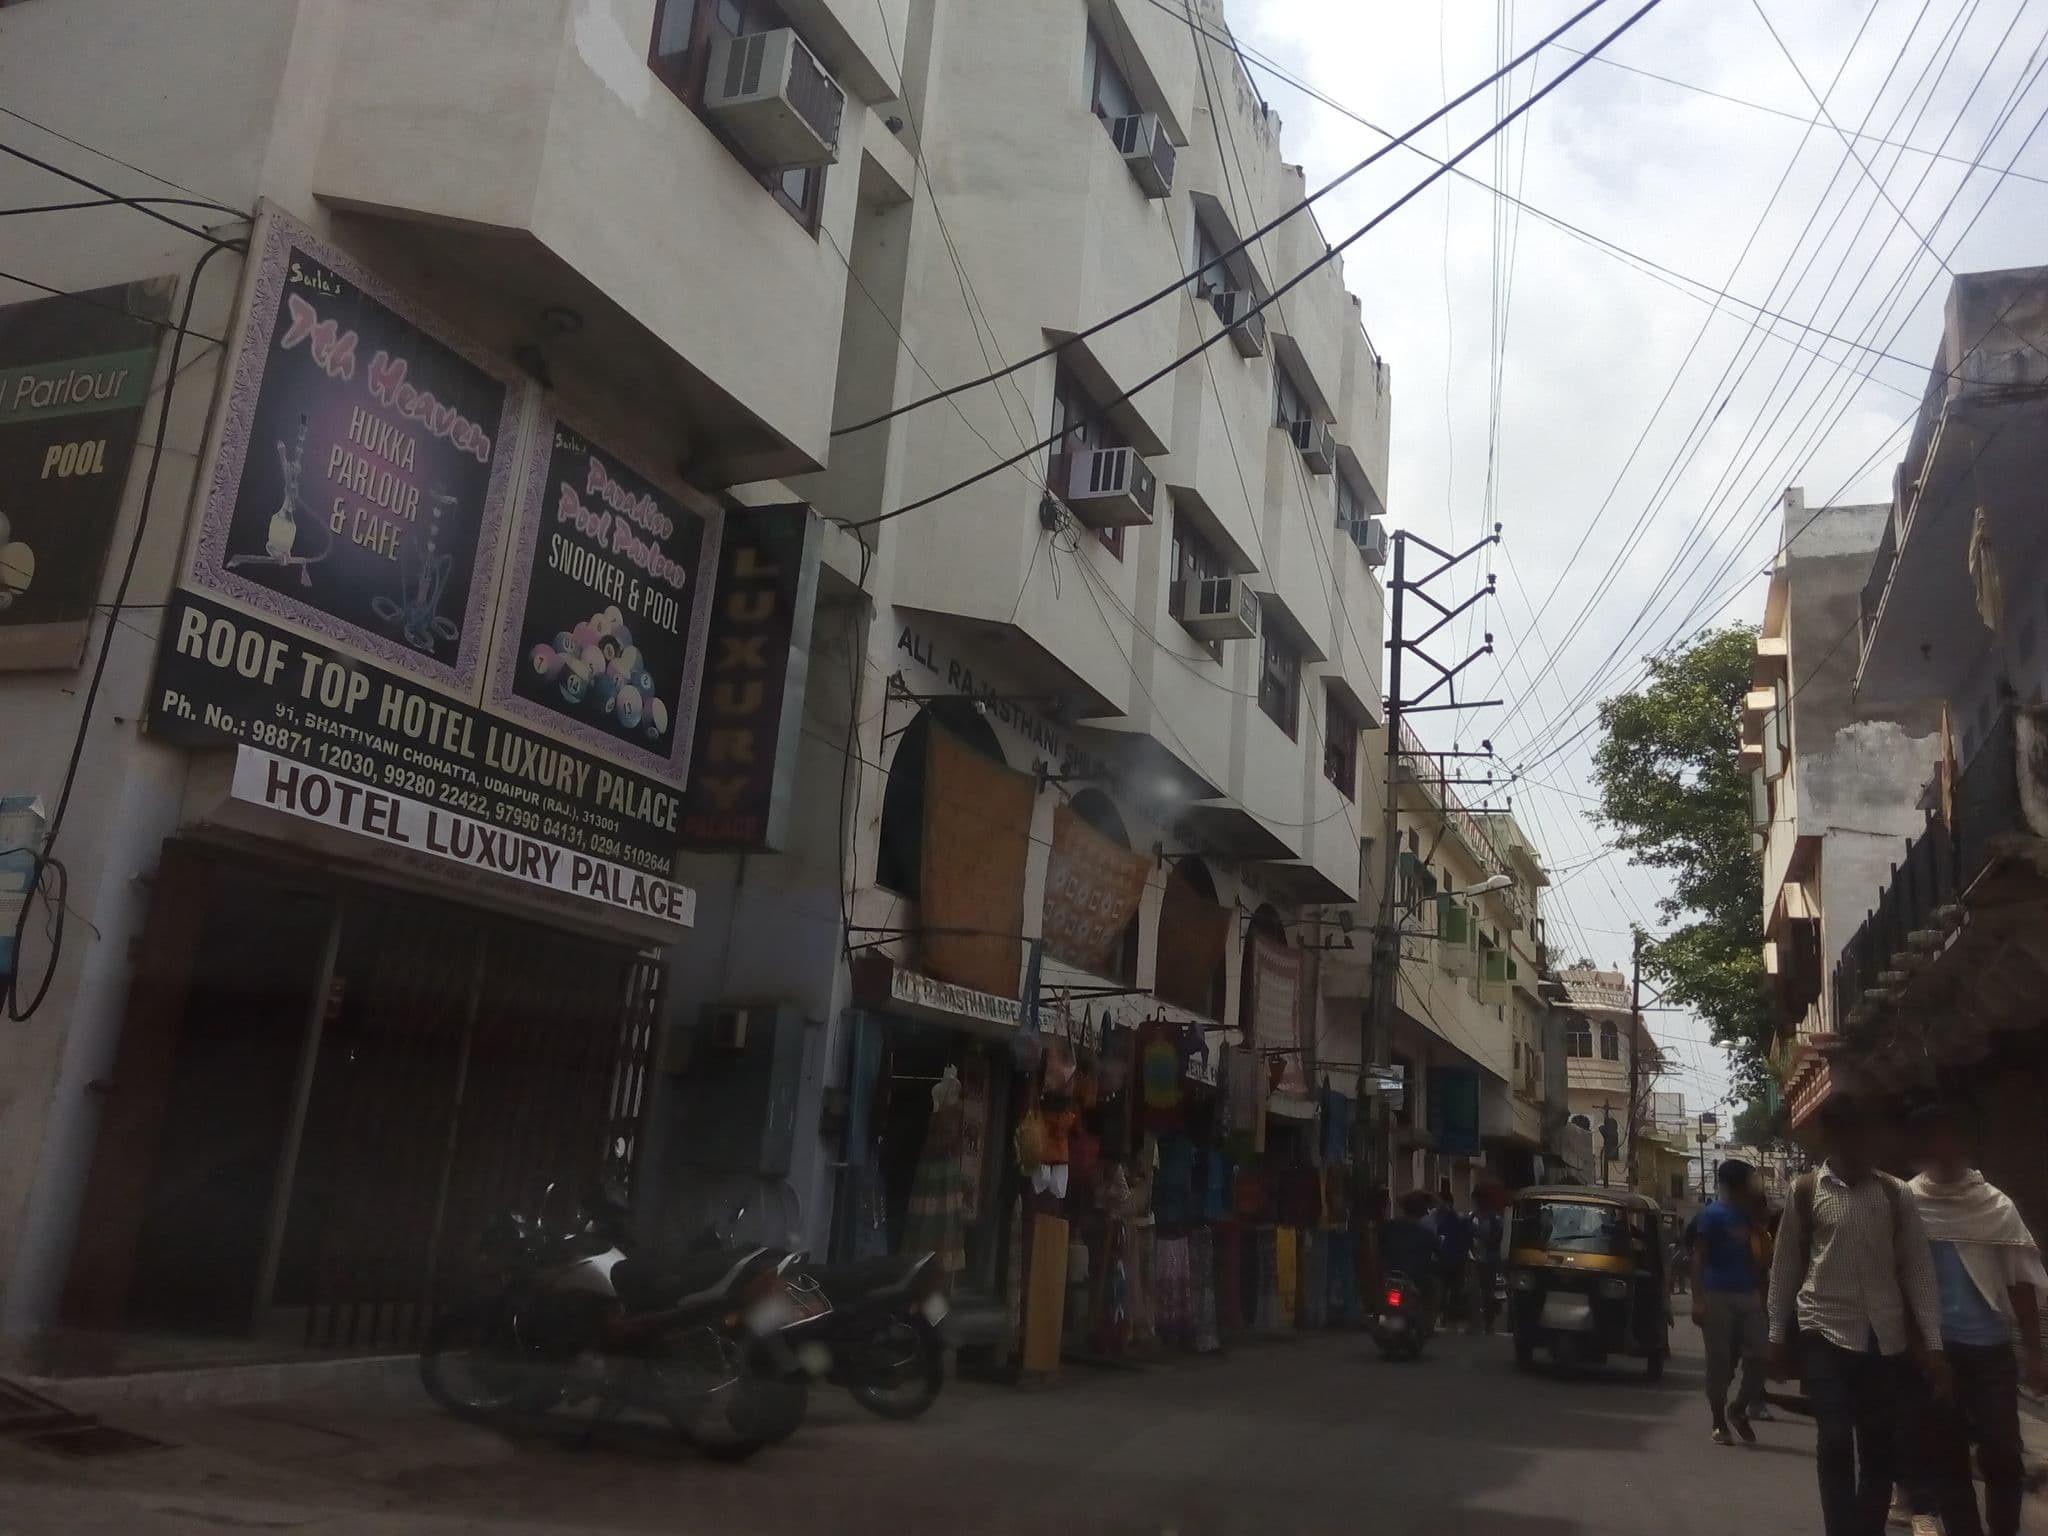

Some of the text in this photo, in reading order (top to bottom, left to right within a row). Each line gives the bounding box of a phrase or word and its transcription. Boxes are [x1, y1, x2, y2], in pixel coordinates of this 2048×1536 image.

[12, 367, 129, 410] Parlour
[368, 350, 491, 463] Heaven
[40, 439, 108, 480] POOL
[327, 443, 420, 523] PARLOUR
[349, 405, 416, 473] HUKKA
[329, 497, 402, 561] & CAFE
[557, 481, 611, 548] Pool
[549, 533, 679, 635] SNOOKER & POOL
[700, 547, 783, 812] LUXURY
[897, 626, 938, 675] ALL
[176, 606, 680, 833] ROOF TOP HOTEL LUXURY PALACE
[162, 690, 197, 721] Ph.
[204, 703, 247, 737] No.:
[252, 720, 313, 757] 98871
[319, 743, 378, 784] 12030,
[383, 763, 436, 798] 99280
[439, 783, 489, 819] 22422,
[494, 802, 540, 832] 97990
[543, 817, 587, 849] 04131,
[590, 834, 620, 859] 0294
[304, 712, 398, 757] BHATTIYANI
[402, 747, 480, 788] CHOHATTA,
[484, 776, 540, 806] UDAIPUR
[582, 810, 620, 833] 313001
[266, 759, 409, 843] HOTEL
[426, 811, 560, 884] LUXURY
[572, 855, 684, 920] PALACE
